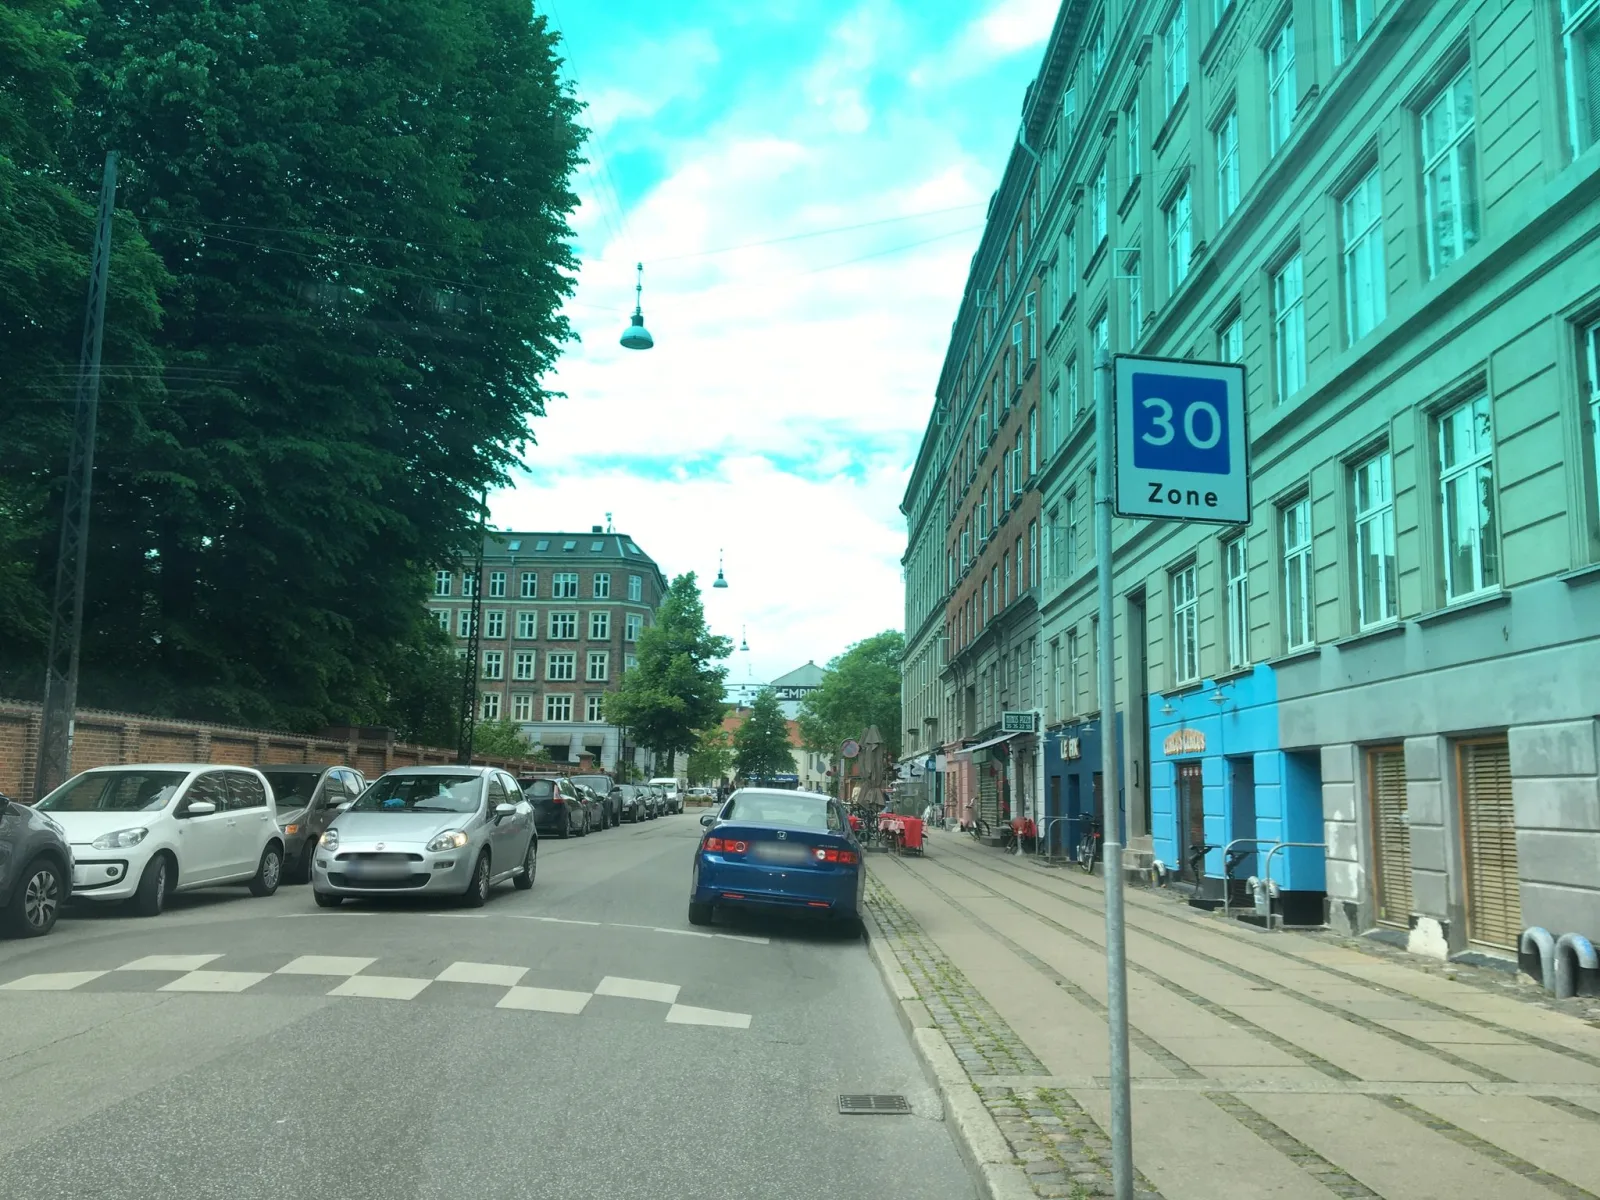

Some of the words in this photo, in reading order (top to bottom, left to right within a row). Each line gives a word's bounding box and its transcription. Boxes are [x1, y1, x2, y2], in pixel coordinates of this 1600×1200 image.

[1142, 397, 1222, 449] 30
[1148, 482, 1218, 507] Zone
[1019, 715, 1032, 724] PIZZA
[1060, 738, 1068, 759] LE
